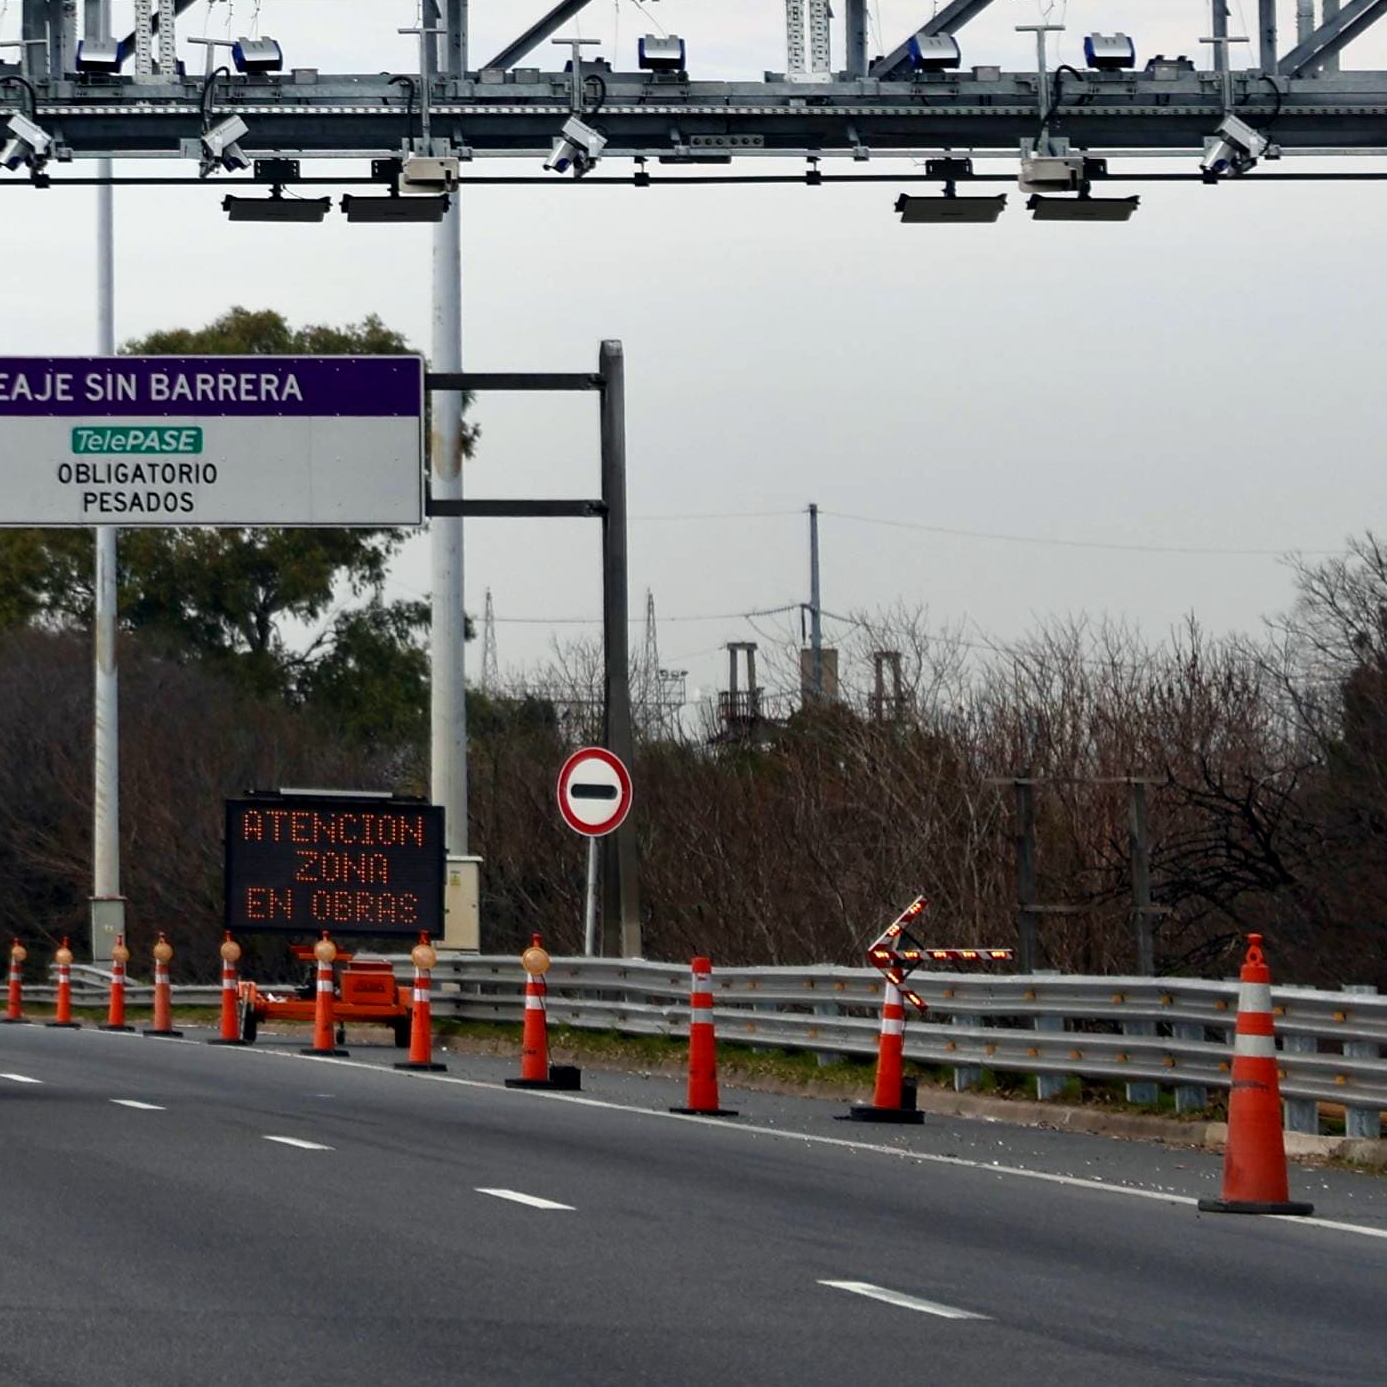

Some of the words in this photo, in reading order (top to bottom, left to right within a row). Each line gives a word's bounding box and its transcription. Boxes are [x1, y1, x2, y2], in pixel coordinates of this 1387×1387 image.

[85, 373, 137, 402] SIN
[150, 373, 303, 402] BARRERA
[77, 429, 197, 452] TelePASE
[58, 463, 218, 485] OBLIGATORIO
[83, 492, 195, 513] PESADOS
[243, 810, 423, 847] ATENCION
[295, 850, 388, 884] ZONA
[247, 887, 292, 919] EN
[312, 889, 418, 923] OBRAS
